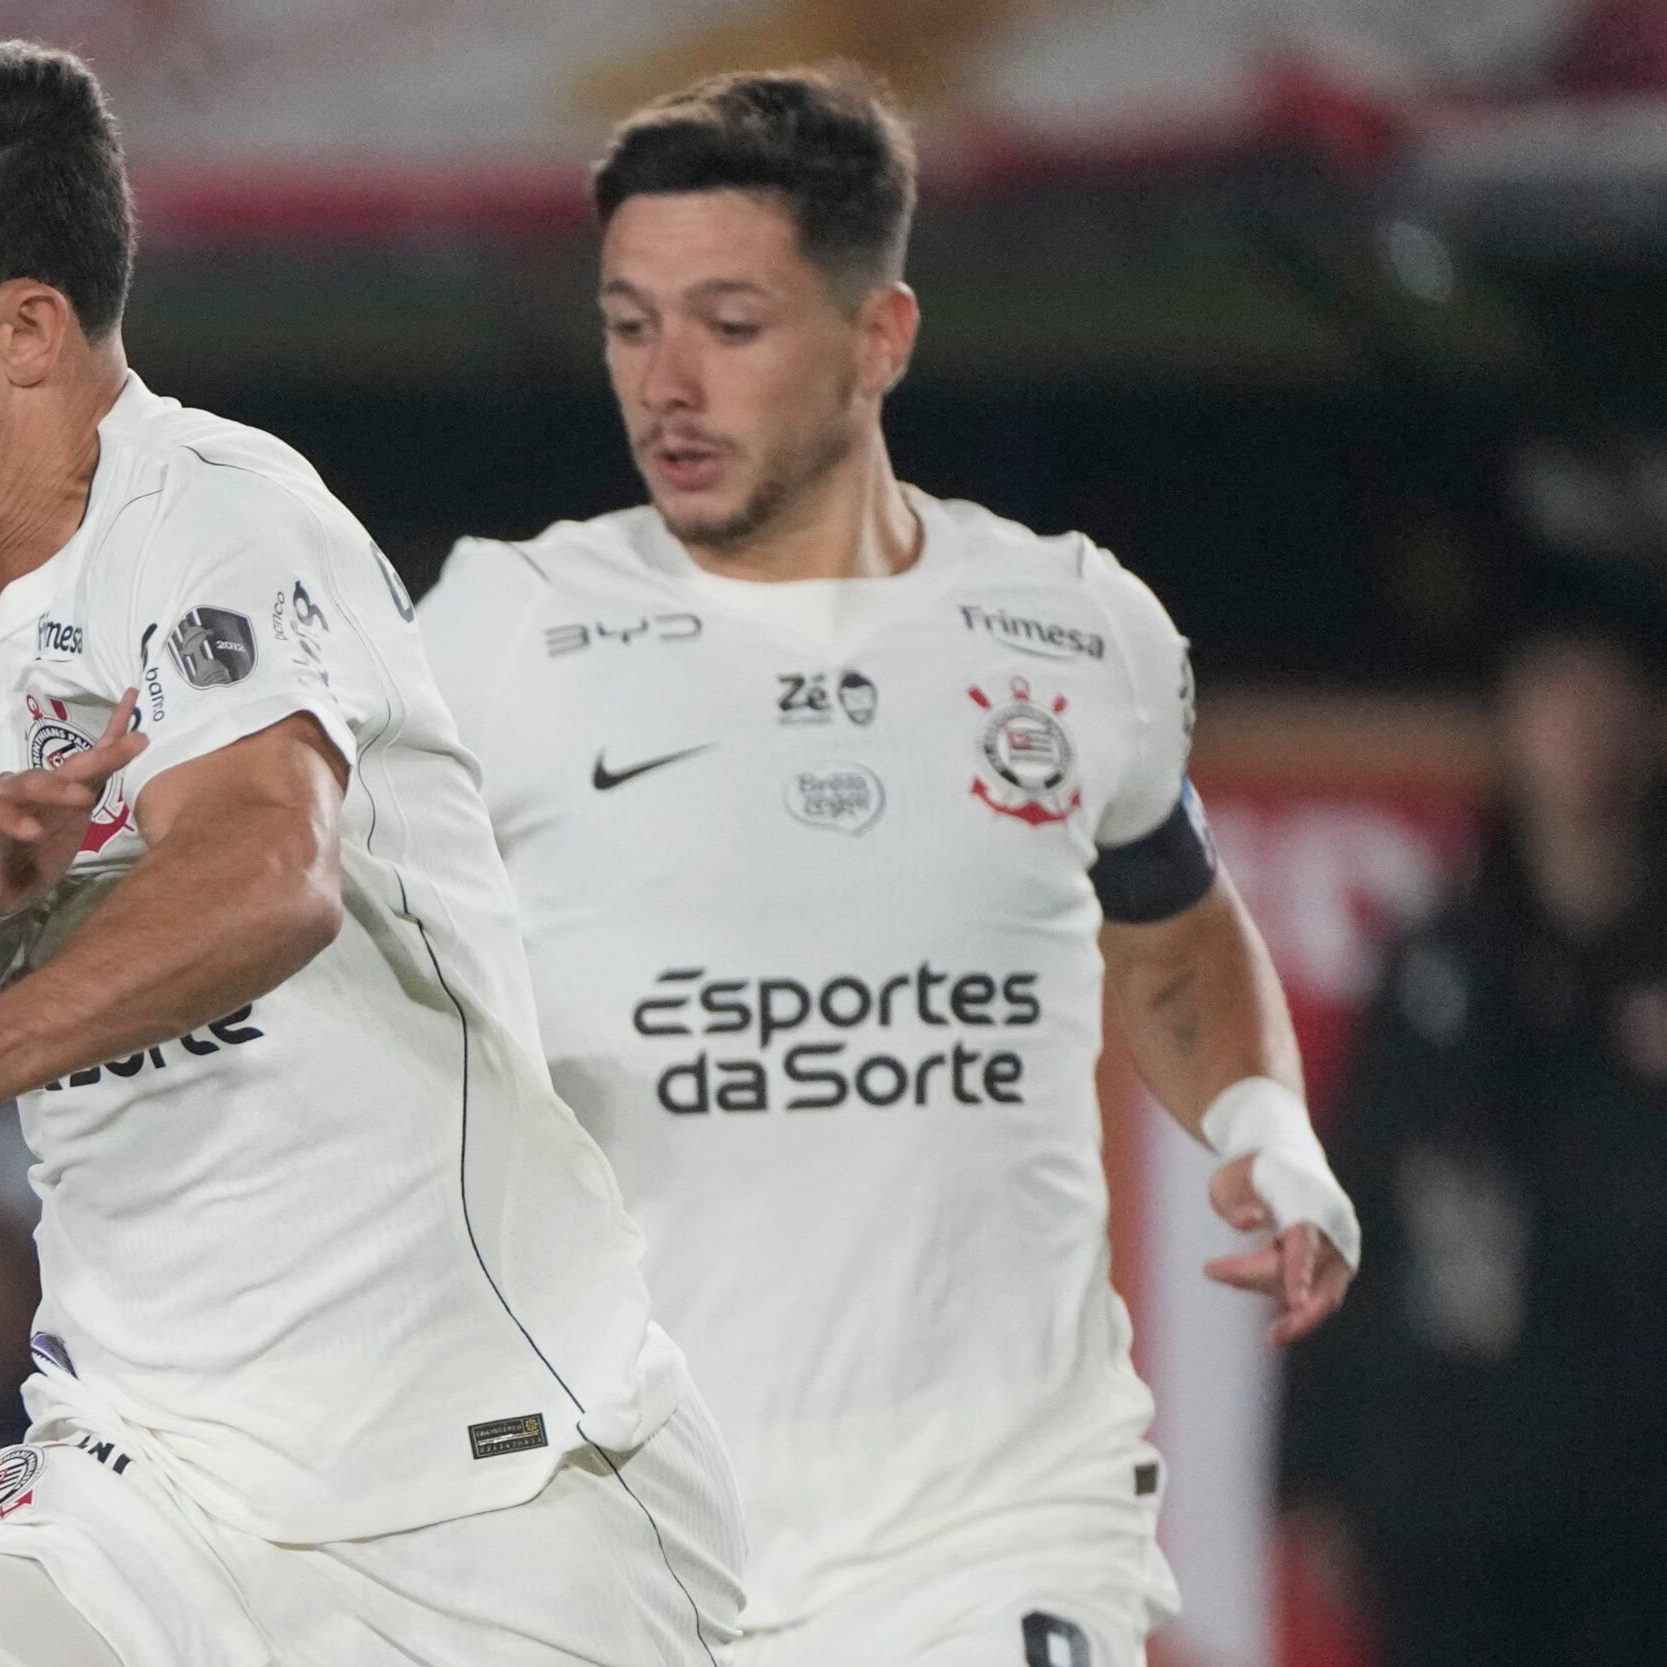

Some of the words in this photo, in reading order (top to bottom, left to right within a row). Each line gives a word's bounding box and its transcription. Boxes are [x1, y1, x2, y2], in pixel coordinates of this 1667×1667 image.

[544, 613, 703, 657] BYD
[959, 605, 1105, 660] Frimesa
[777, 674, 830, 711] Zé
[634, 960, 1042, 1050] Esportes
